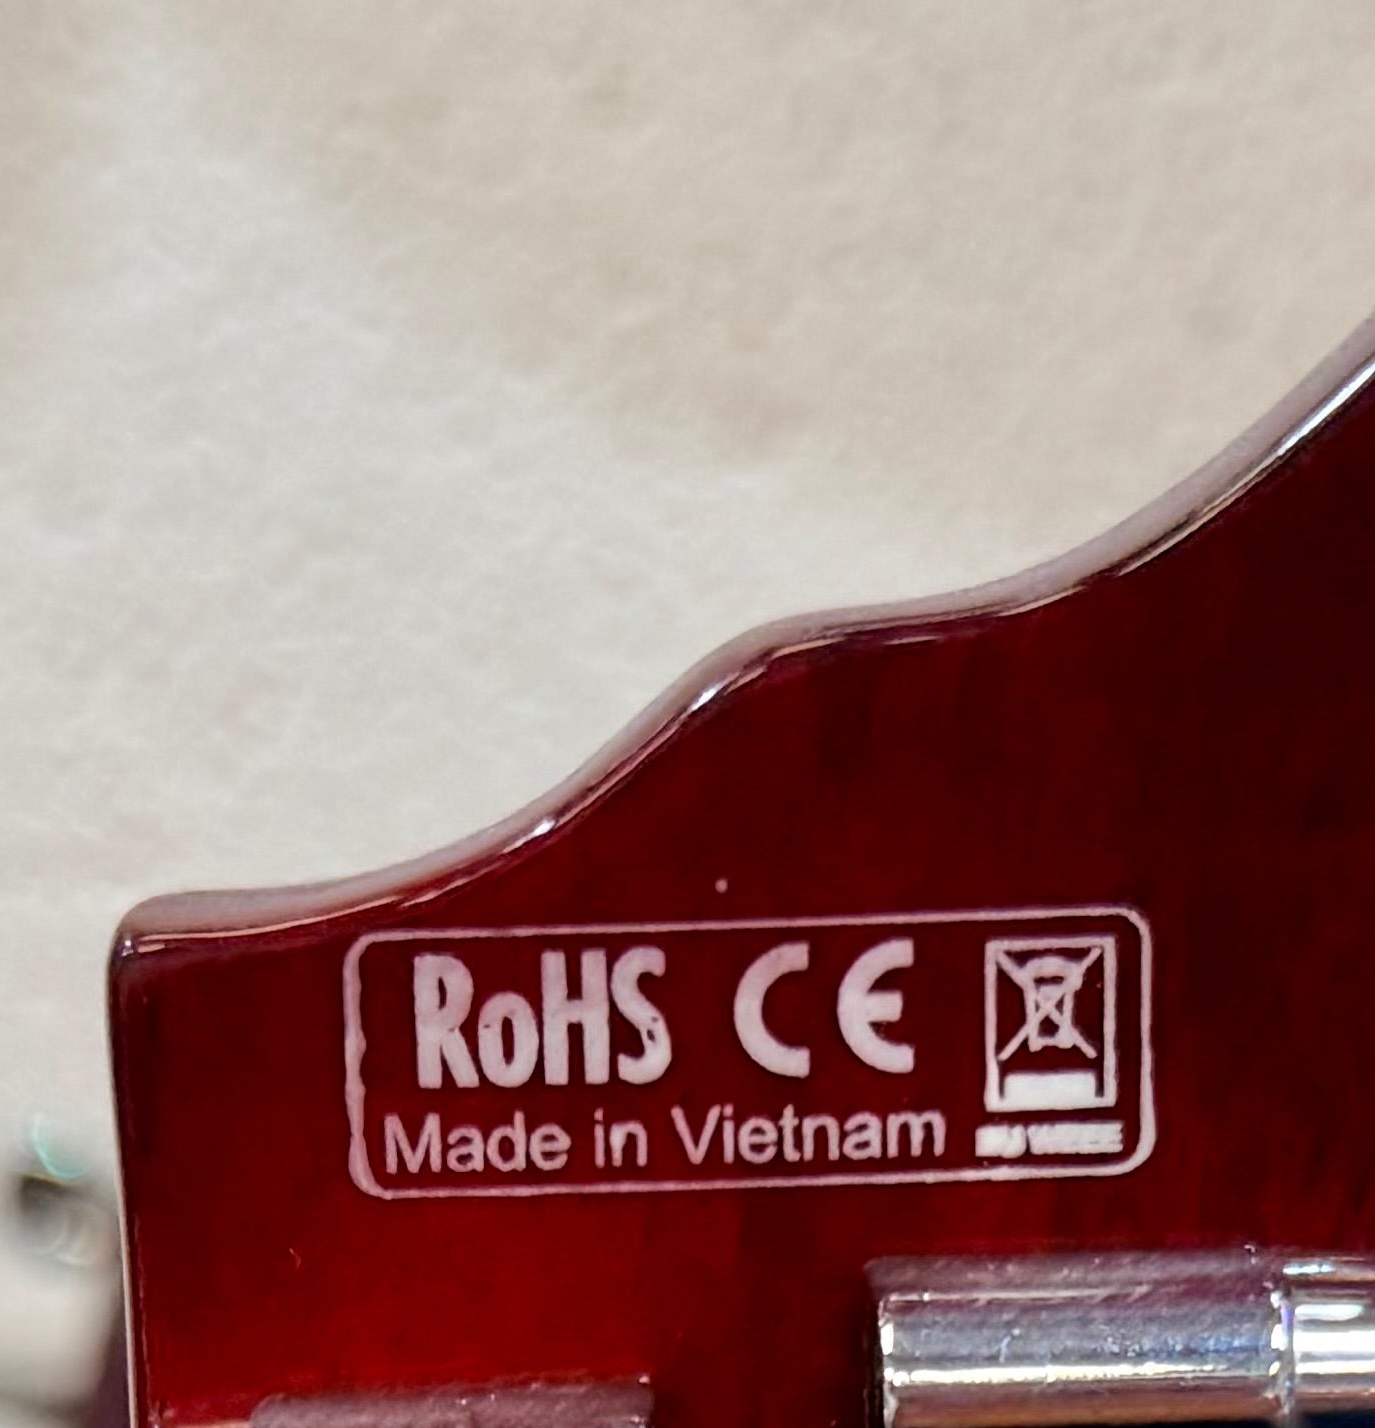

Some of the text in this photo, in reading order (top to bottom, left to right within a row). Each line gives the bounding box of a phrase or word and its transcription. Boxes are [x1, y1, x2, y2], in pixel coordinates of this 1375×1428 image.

[413, 946, 673, 1090] RoHS
[383, 1110, 573, 1175] Made
[593, 1109, 649, 1168] in
[670, 1103, 947, 1166] Vietnam
